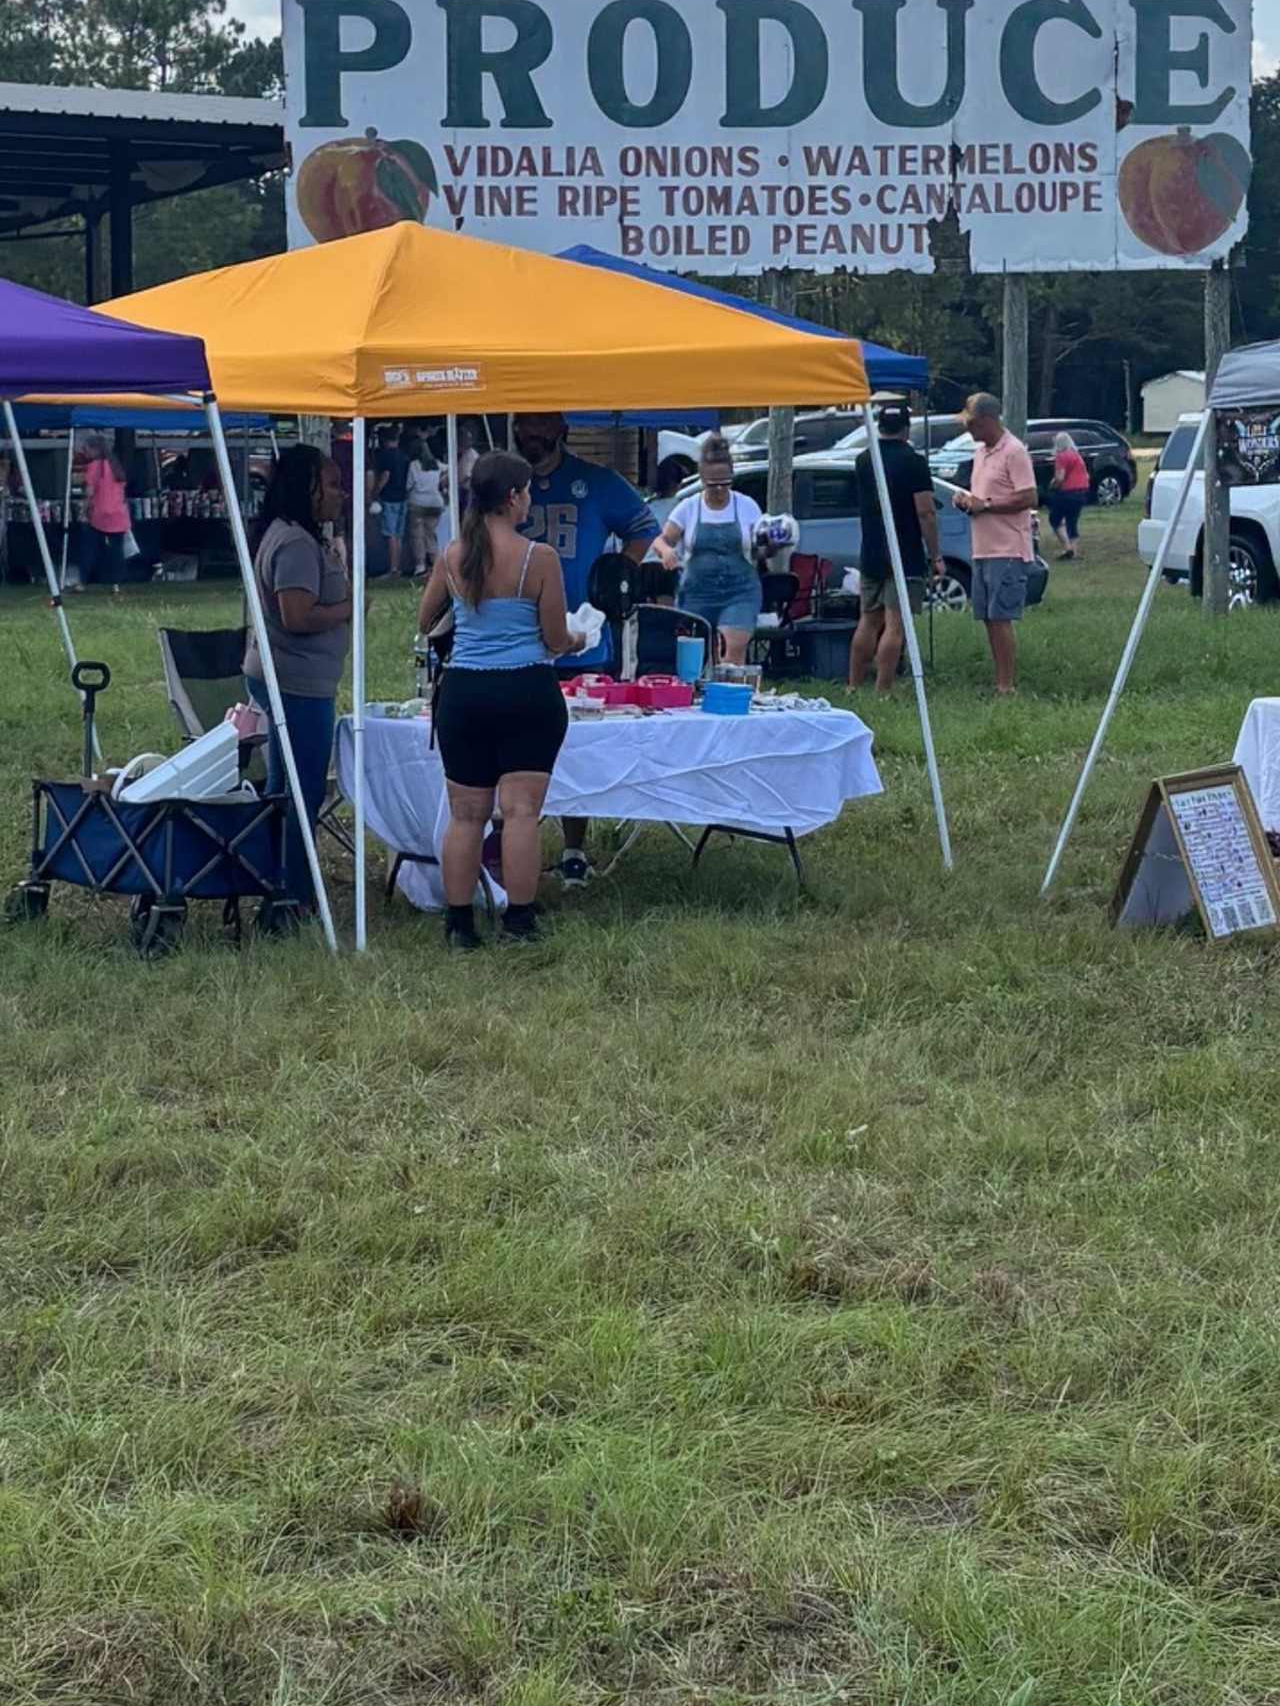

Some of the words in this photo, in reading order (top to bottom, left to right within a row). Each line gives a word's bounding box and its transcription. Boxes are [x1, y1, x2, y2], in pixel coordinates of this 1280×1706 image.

[443, 145, 605, 178] VIDALIA
[619, 145, 761, 178] ONIONS
[802, 142, 1099, 177] WATERMELONS
[442, 184, 538, 218] VINE
[557, 184, 641, 218] RIPE
[659, 184, 852, 218] TOMATOES
[875, 180, 1103, 215] CANTALOUPE
[621, 224, 751, 256] BOILED
